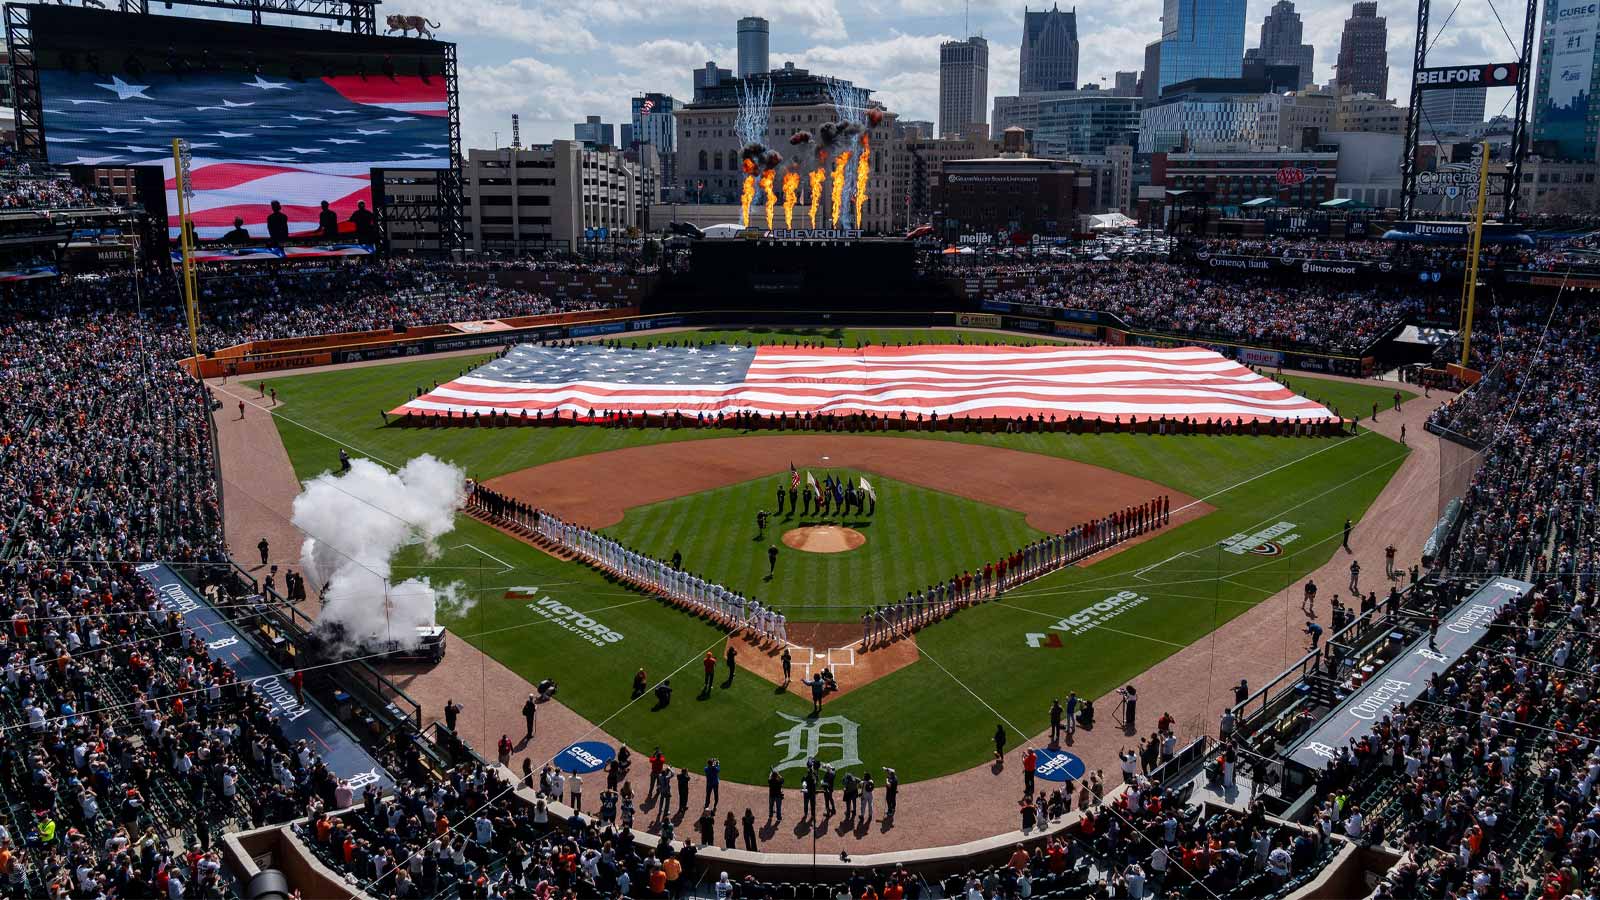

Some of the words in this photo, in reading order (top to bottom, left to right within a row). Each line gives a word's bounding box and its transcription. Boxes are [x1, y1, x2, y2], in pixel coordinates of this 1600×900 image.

[1567, 35, 1581, 48] #1
[1416, 69, 1481, 84] BELFOR
[774, 230, 865, 238] CHEVROLET
[960, 232, 993, 244] meijer
[98, 250, 128, 260] MARKET
[634, 322, 651, 330] DTE
[1048, 590, 1138, 632] VICTORS
[1072, 620, 1102, 636] HOME
[1100, 596, 1149, 622] SOLUTIONS
[526, 603, 554, 619] HOME
[551, 616, 606, 647] SOLUTIONS
[536, 596, 624, 643] VICTORS
